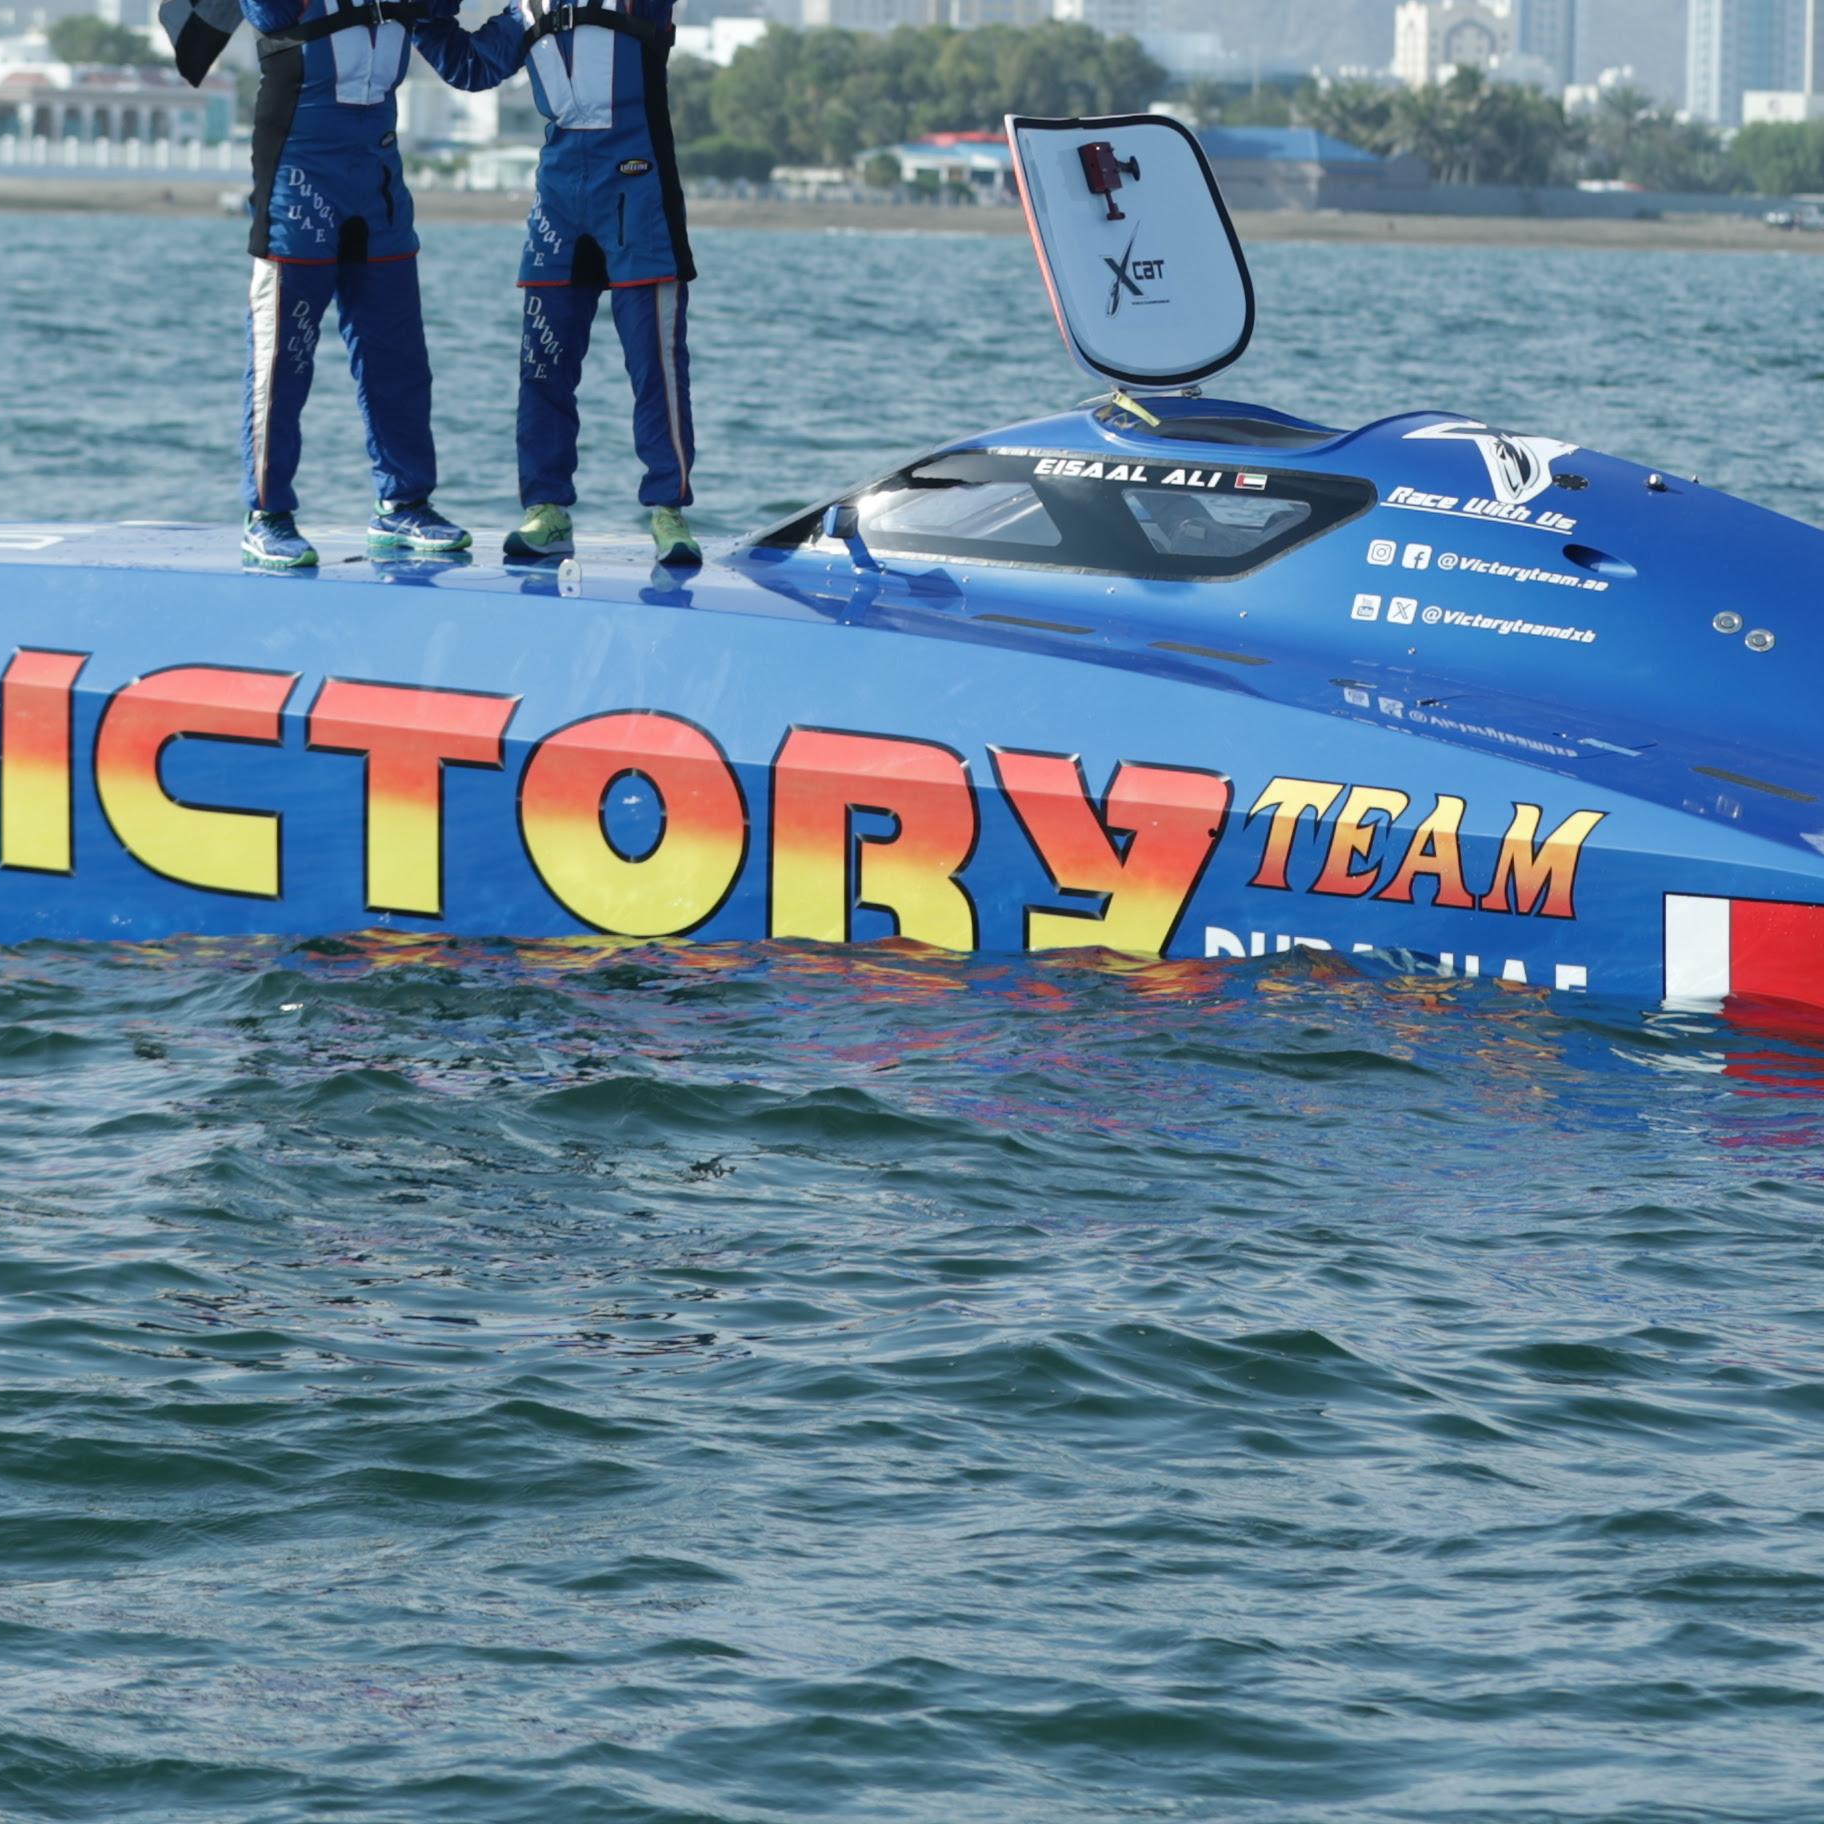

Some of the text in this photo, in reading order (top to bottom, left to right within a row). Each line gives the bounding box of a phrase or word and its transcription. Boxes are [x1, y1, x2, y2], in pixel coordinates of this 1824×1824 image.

[1033, 457, 1222, 489] EISAAL ALI
[1386, 485, 1578, 531] Race With Us
[1242, 775, 1611, 920] TEAM
